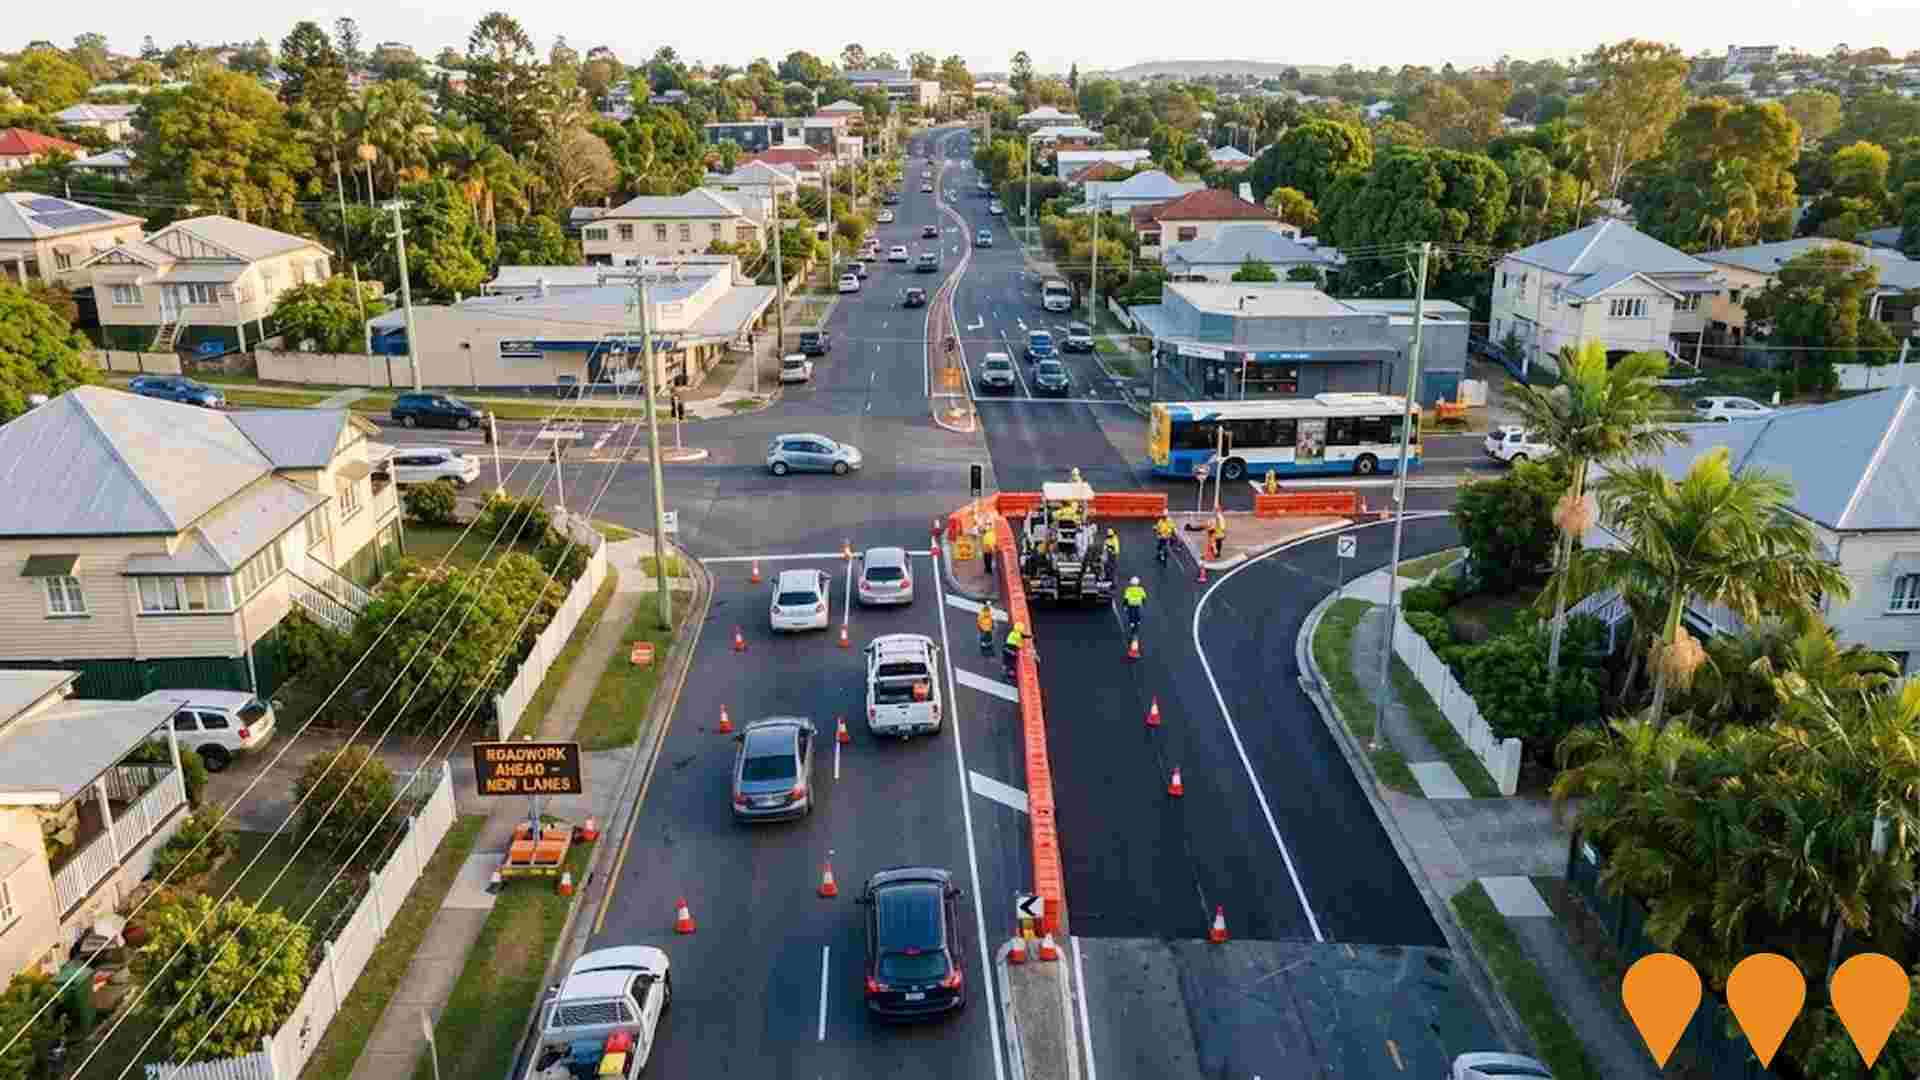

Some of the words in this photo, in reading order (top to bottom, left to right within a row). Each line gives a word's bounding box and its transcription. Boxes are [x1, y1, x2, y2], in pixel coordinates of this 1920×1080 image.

[486, 747, 567, 761] ROADWORK
[496, 763, 545, 776] AHEAD
[487, 778, 517, 792] NEW
[523, 777, 570, 791] LANES
